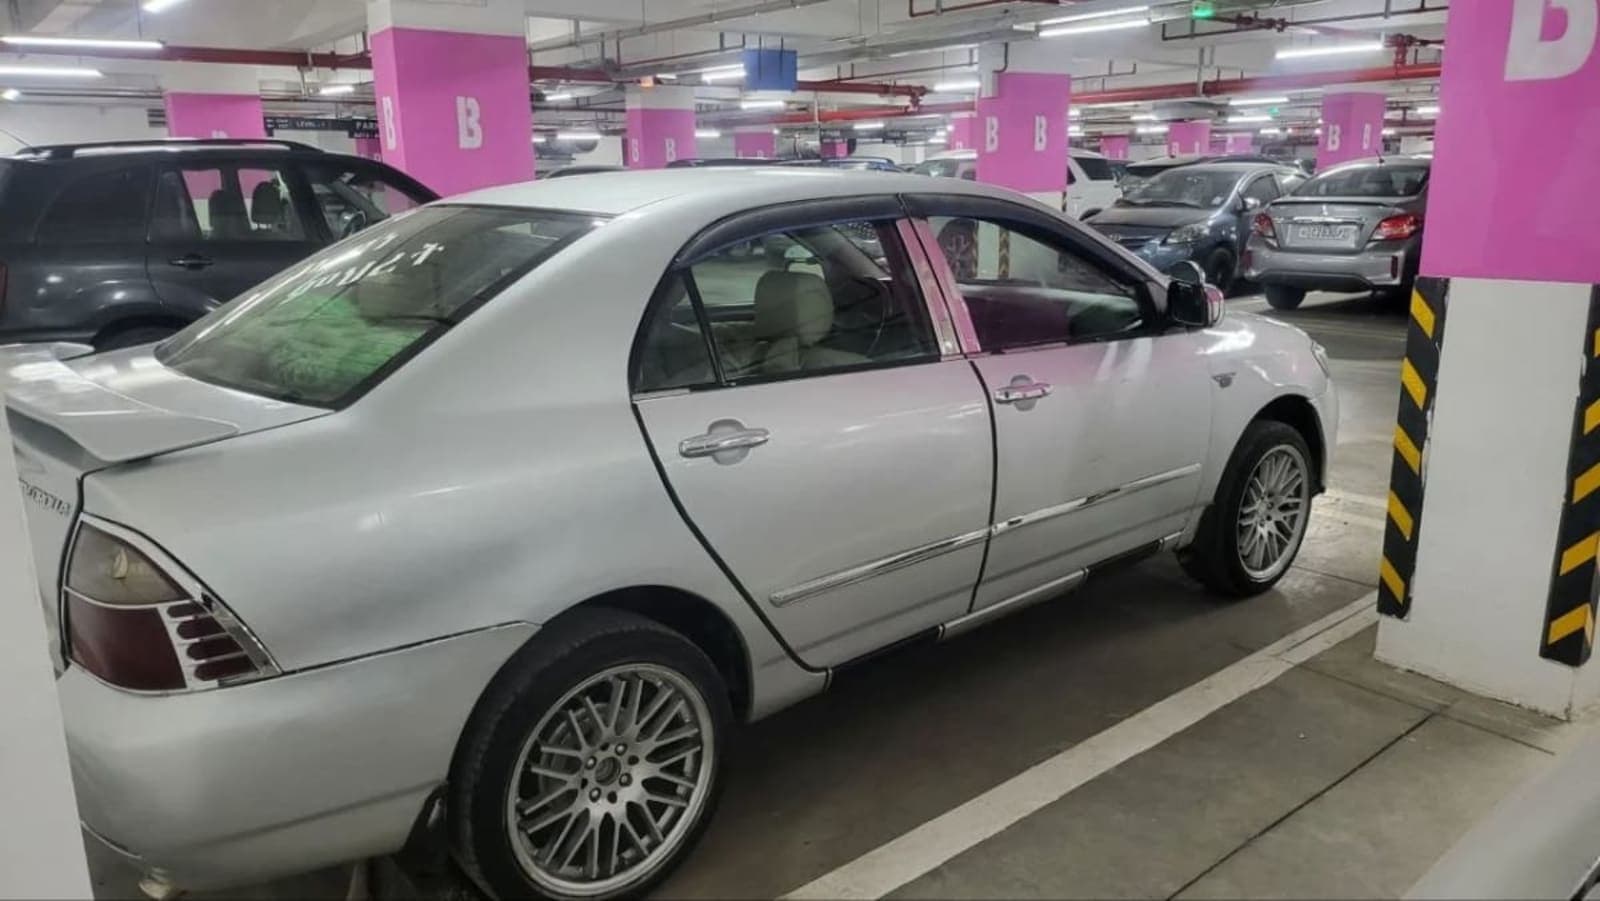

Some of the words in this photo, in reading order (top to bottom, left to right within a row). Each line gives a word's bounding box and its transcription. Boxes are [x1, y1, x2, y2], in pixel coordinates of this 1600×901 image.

[382, 96, 396, 150] B
[456, 95, 482, 149] B
[985, 116, 998, 152] B
[1034, 115, 1047, 151] B
[1328, 124, 1341, 151] B
[664, 138, 677, 162] B
